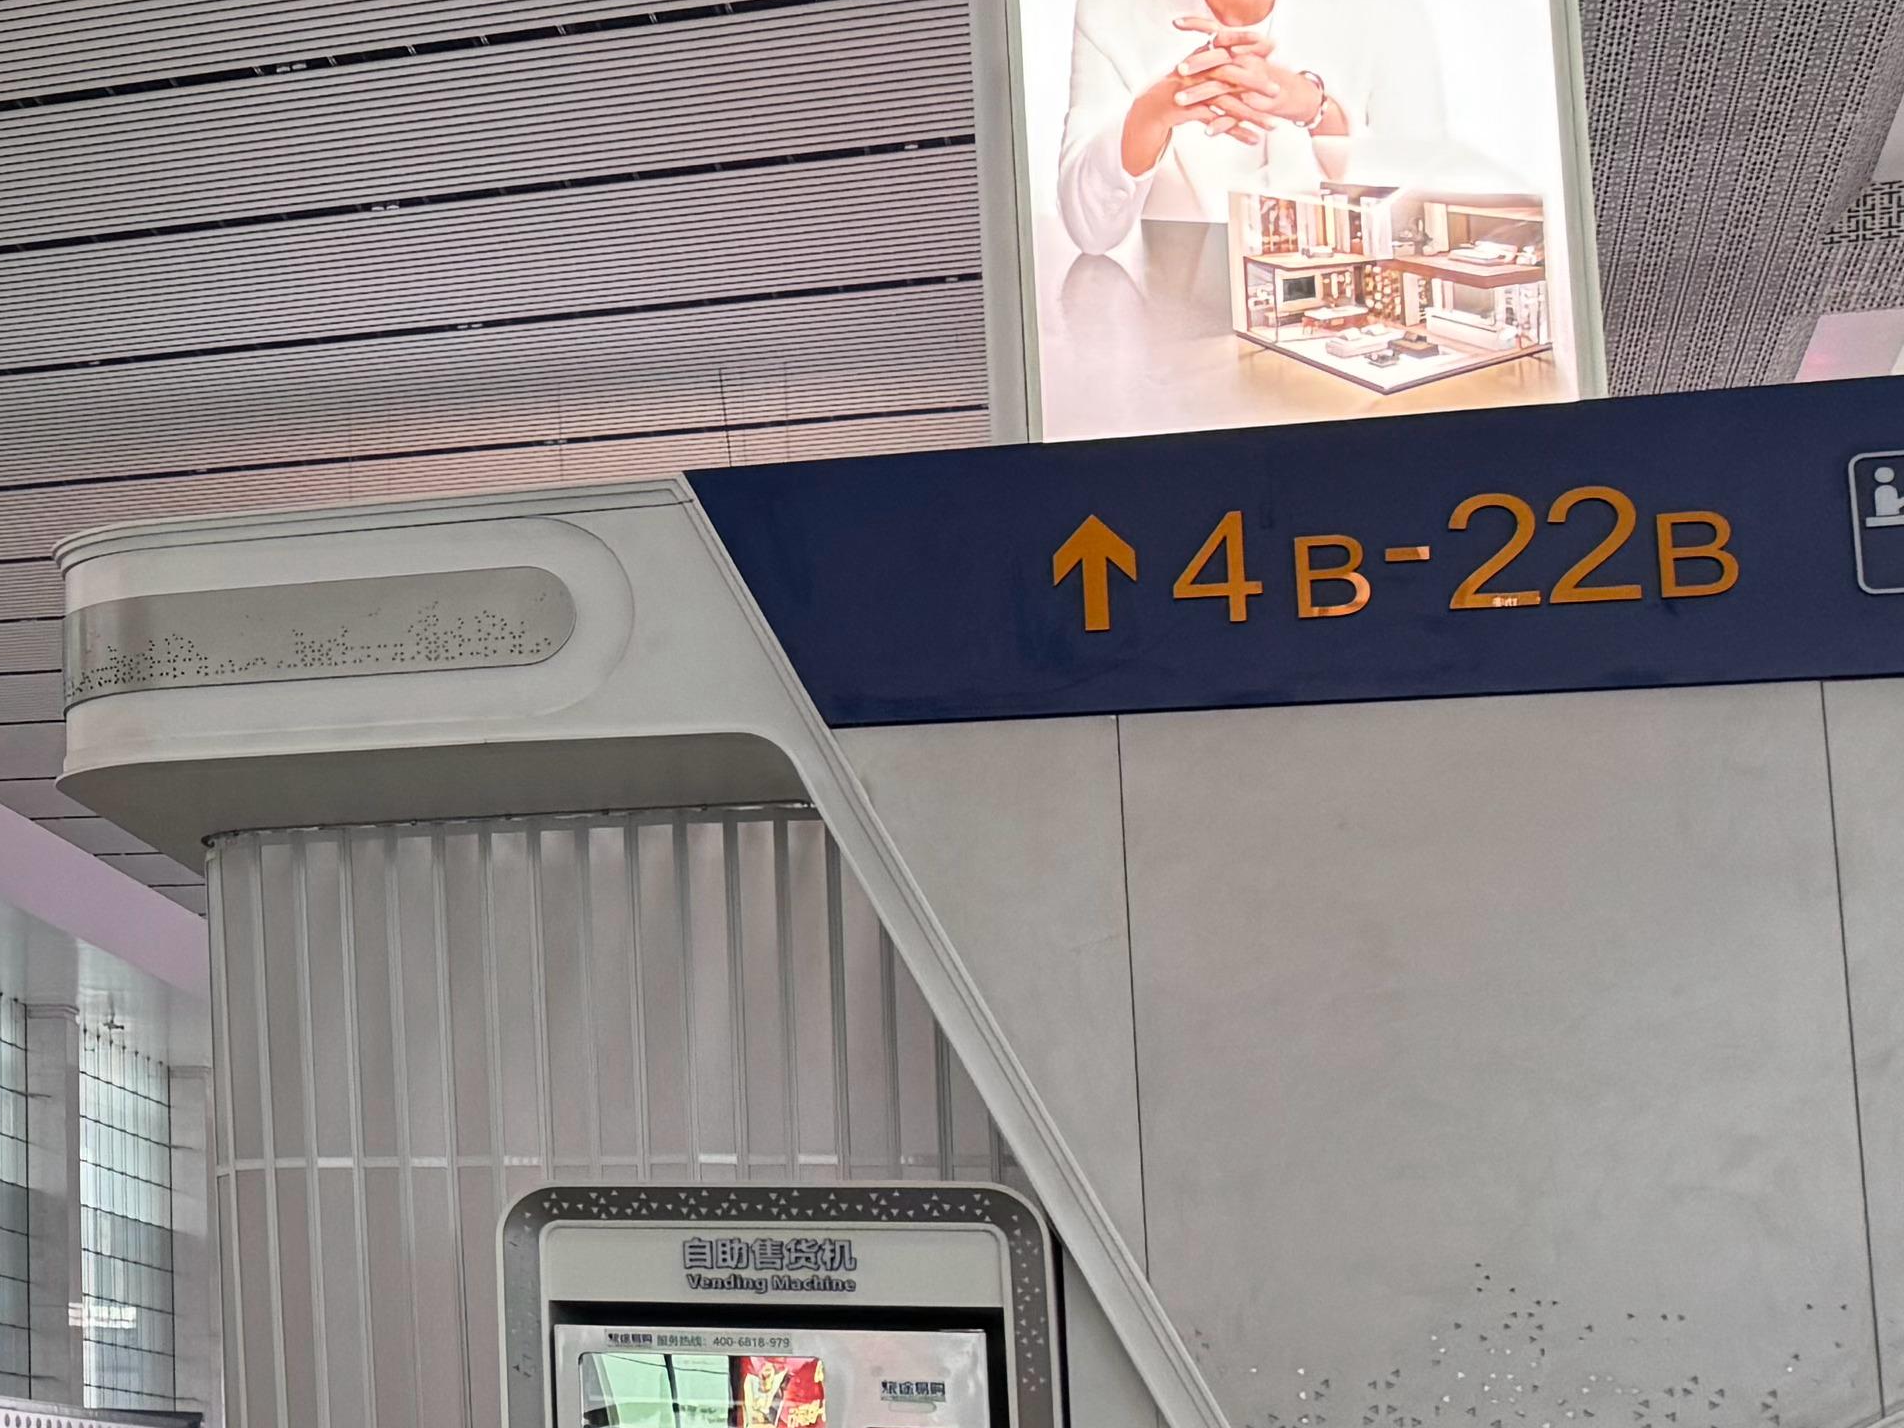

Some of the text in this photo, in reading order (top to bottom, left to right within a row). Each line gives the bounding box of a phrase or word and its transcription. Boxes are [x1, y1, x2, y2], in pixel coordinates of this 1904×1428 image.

[683, 1236, 857, 1272] 自助售货机
[686, 1274, 857, 1294] Vending Machine
[712, 1336, 790, 1349] 400-6818-979
